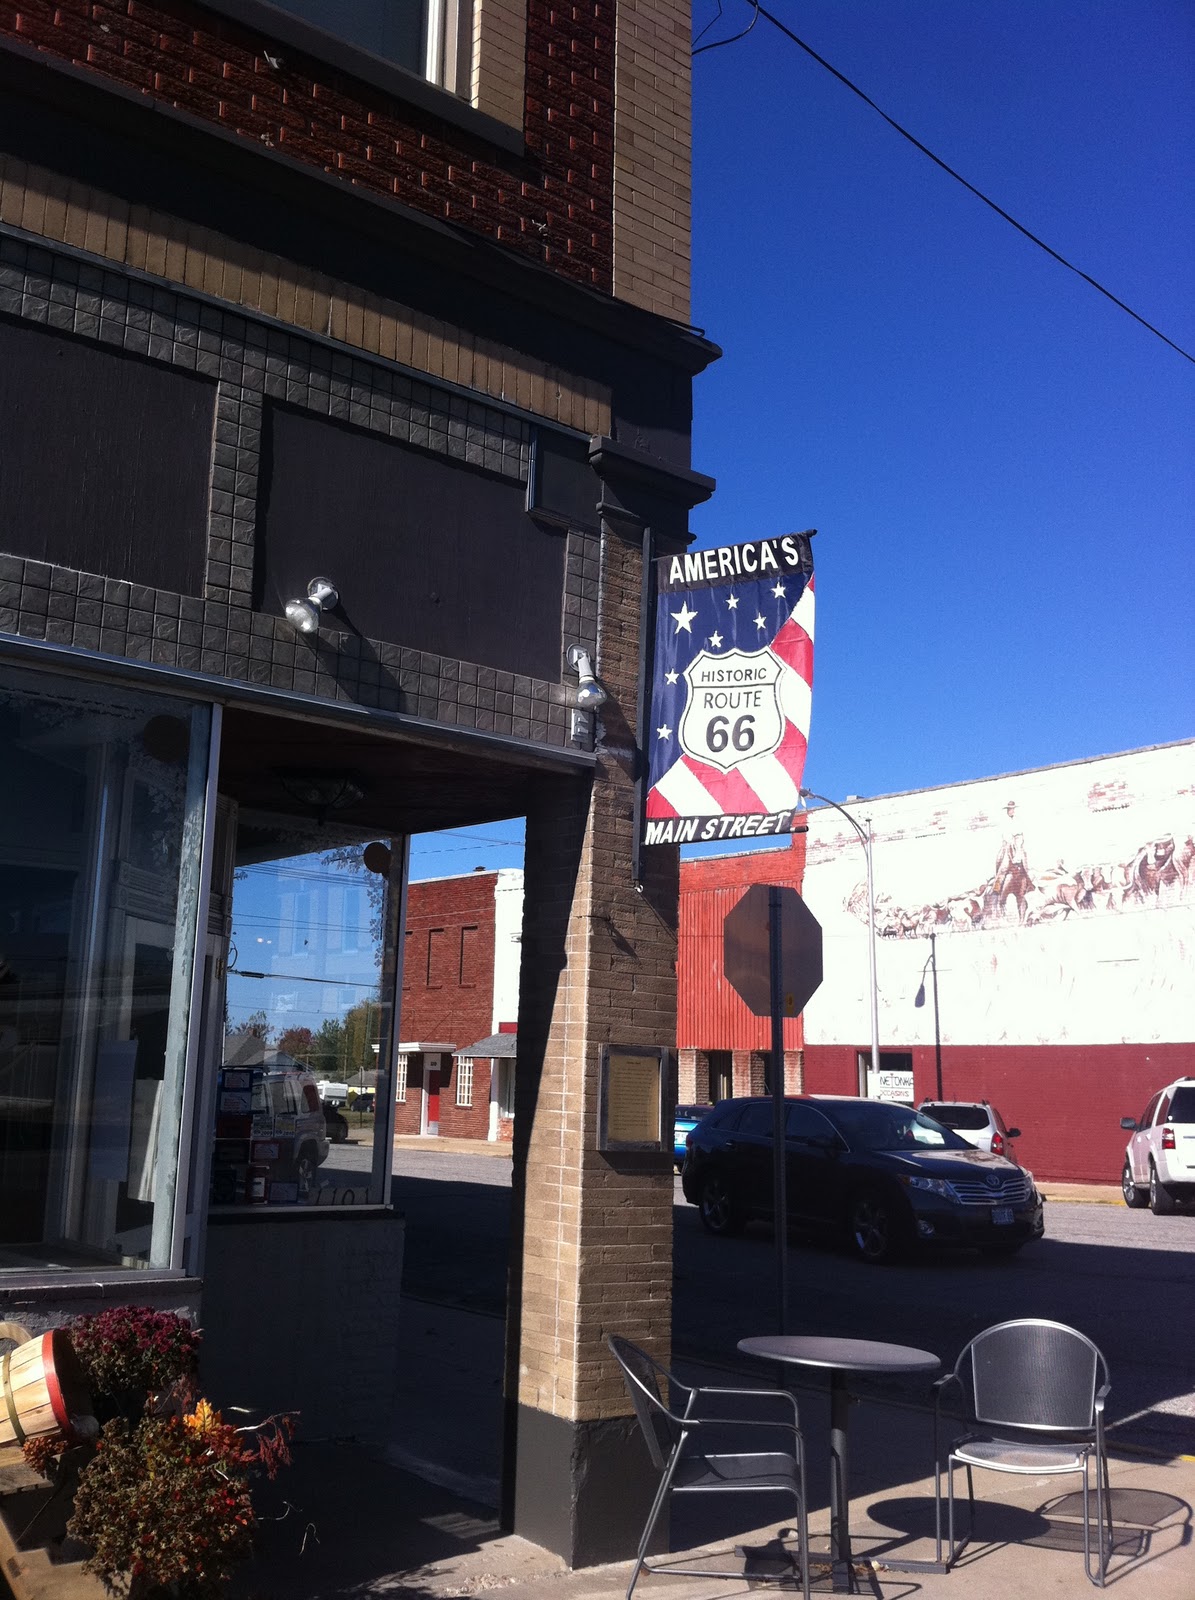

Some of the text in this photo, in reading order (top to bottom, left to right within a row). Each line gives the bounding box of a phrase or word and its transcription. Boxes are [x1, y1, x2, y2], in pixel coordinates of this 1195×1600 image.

[669, 536, 799, 585] AMERICA'S
[701, 667, 767, 683] HISTORIC
[703, 690, 762, 709] ROUTE
[705, 714, 756, 752] 66
[645, 811, 792, 846] MAIN STREET
